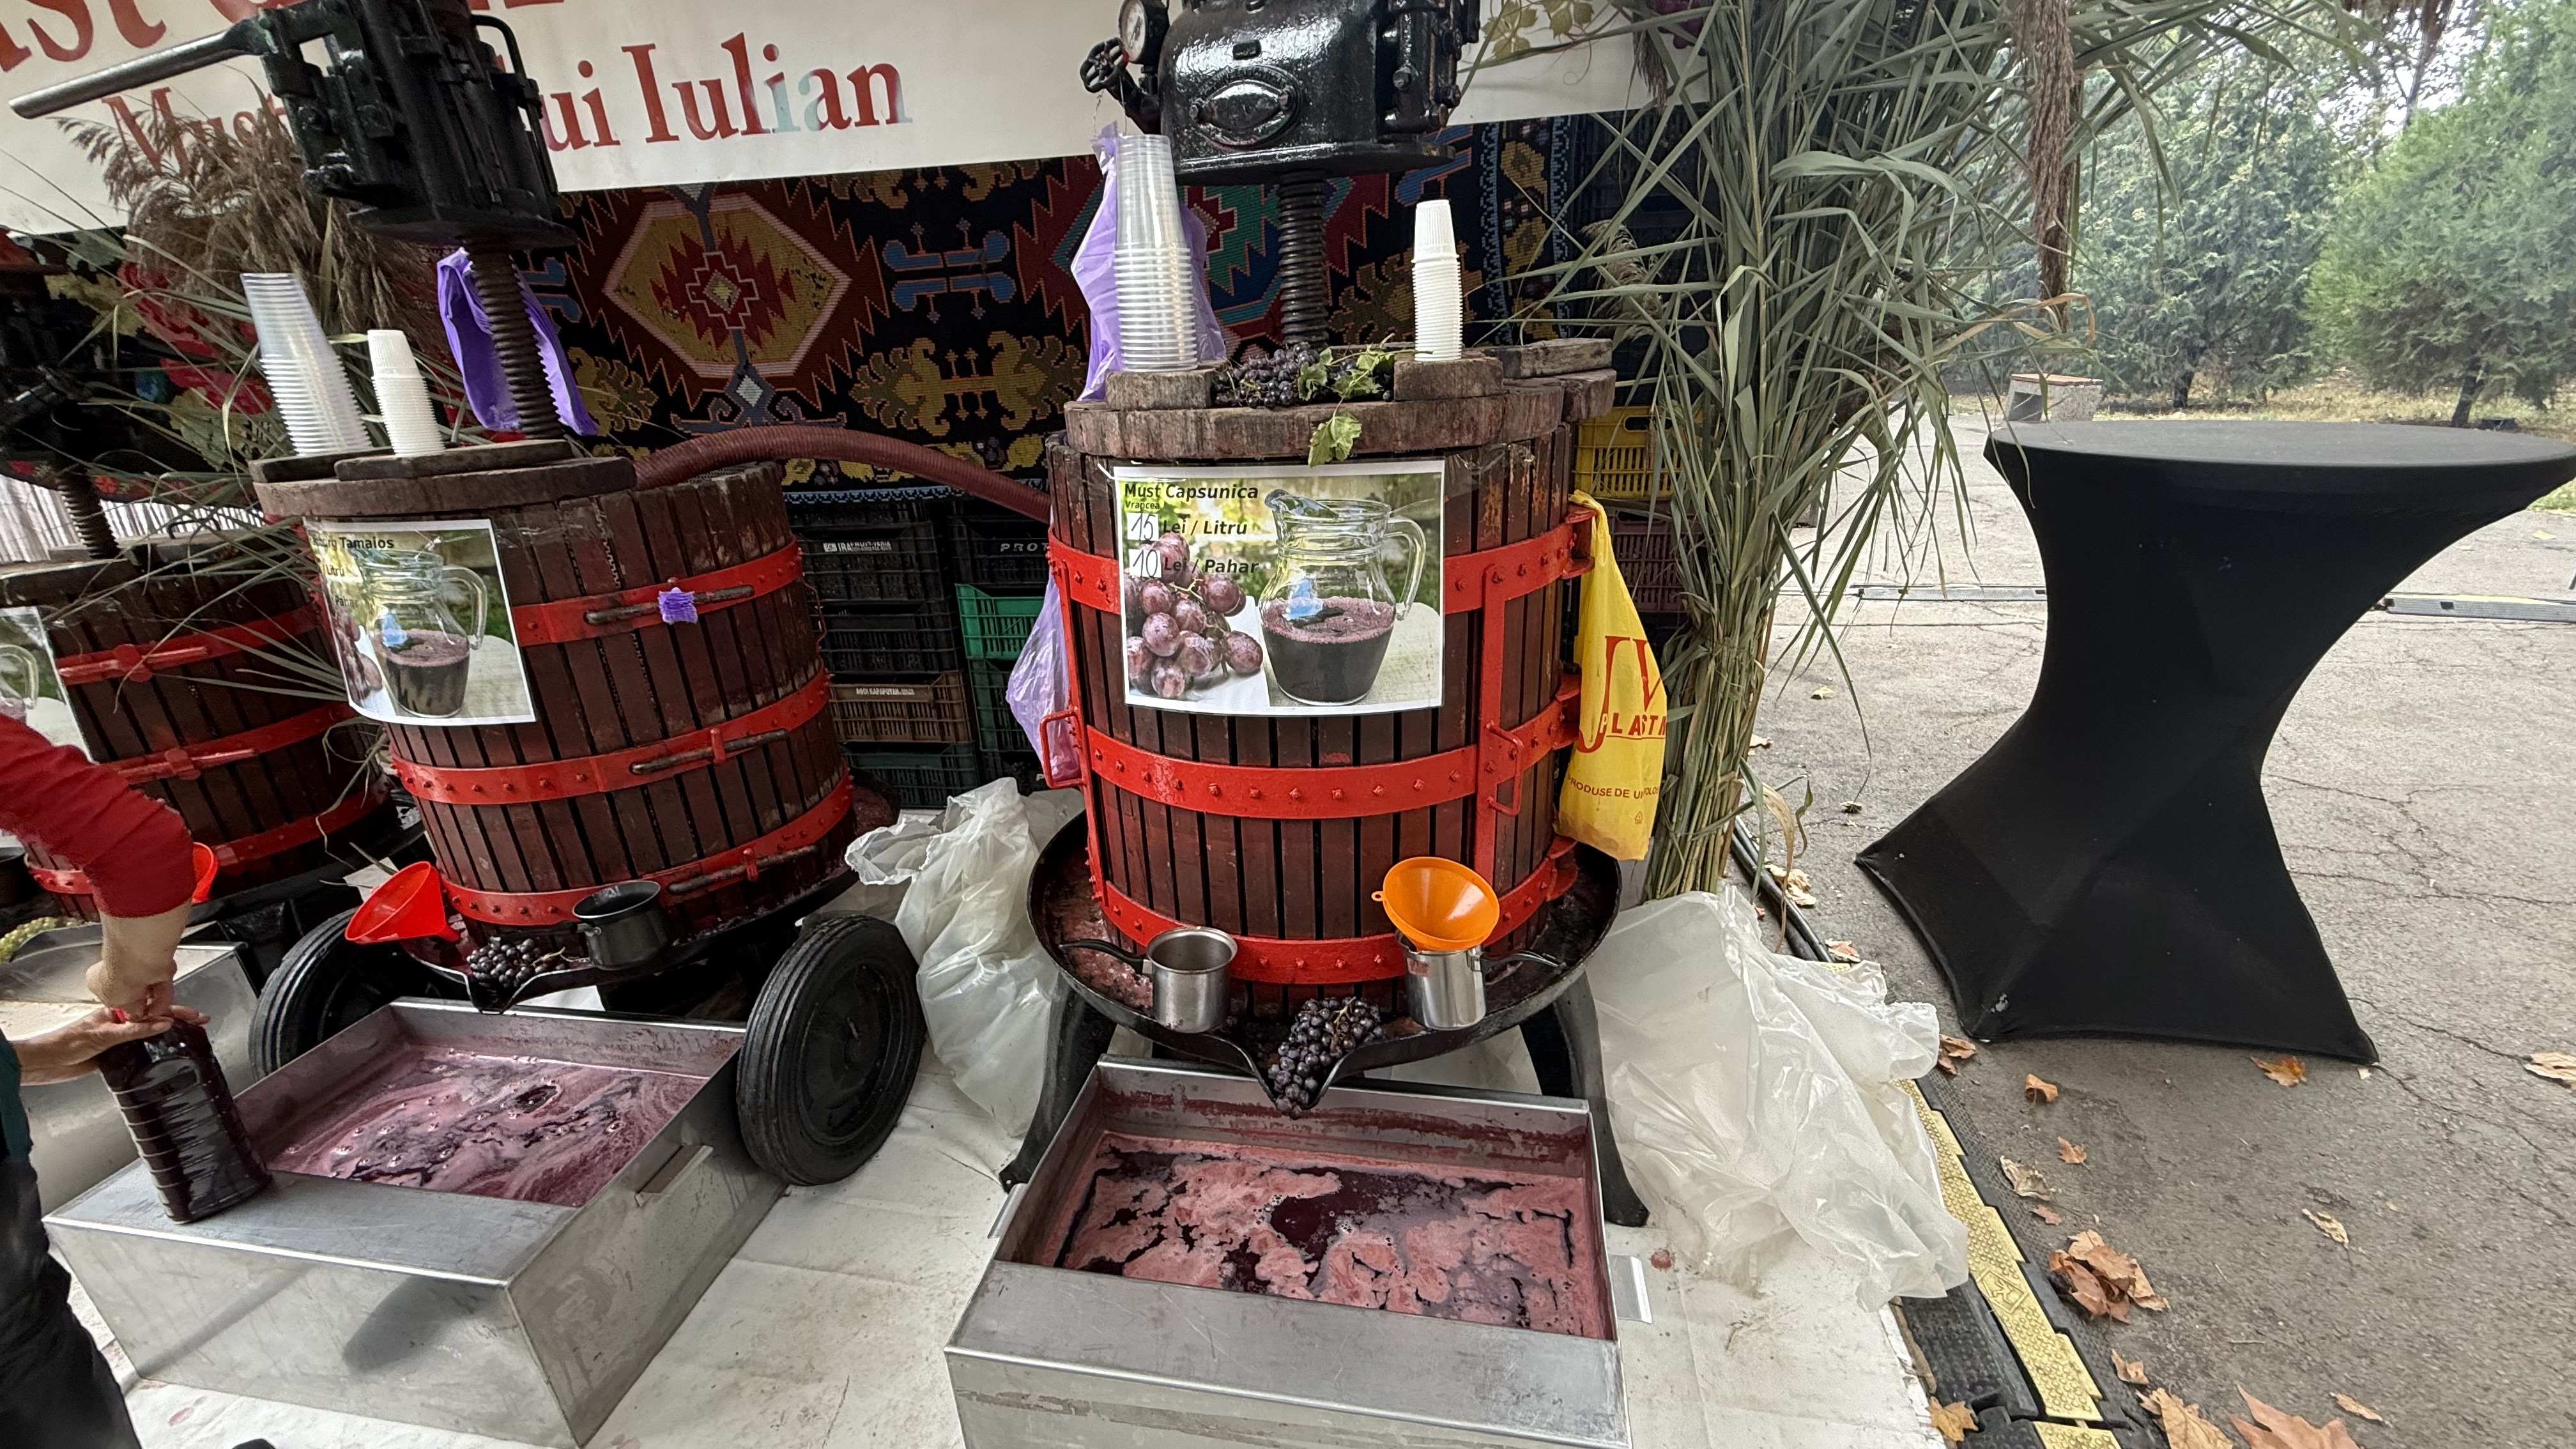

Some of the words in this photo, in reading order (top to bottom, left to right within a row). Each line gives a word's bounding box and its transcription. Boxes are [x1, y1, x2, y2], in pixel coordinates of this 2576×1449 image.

[621, 32, 913, 144] Iulian
[1124, 484, 1161, 498] Must
[1165, 484, 1259, 502] Capsunica
[1131, 512, 1156, 540] 15
[1163, 519, 1186, 534] Lei
[1203, 520, 1248, 535] Litru
[338, 535, 395, 549] Tamaios
[1133, 549, 1158, 578] 10
[1204, 559, 1259, 574] Pahar
[1614, 788, 1630, 799] DE
